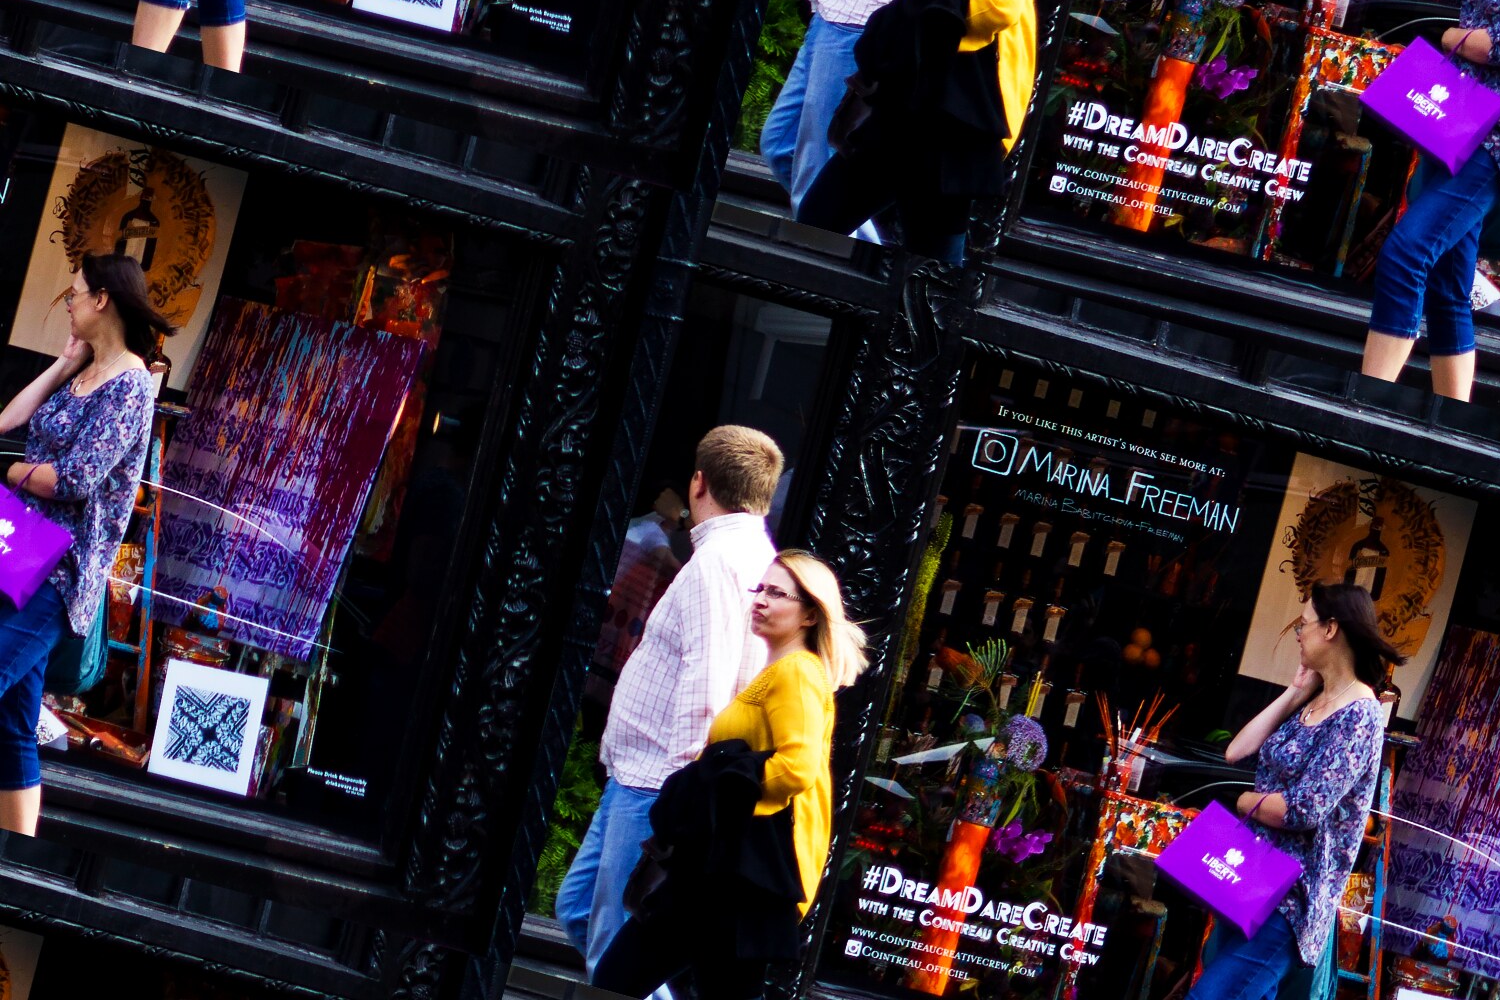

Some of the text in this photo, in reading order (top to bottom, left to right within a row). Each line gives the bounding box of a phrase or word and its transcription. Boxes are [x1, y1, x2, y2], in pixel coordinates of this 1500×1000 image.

[512, 4, 527, 12] Please
[543, 11, 571, 23] Responsibly
[1406, 88, 1446, 119] LIBERTY
[307, 768, 322, 776] Please
[338, 775, 366, 787] Responsibly
[1201, 852, 1241, 883] LIBERTY
